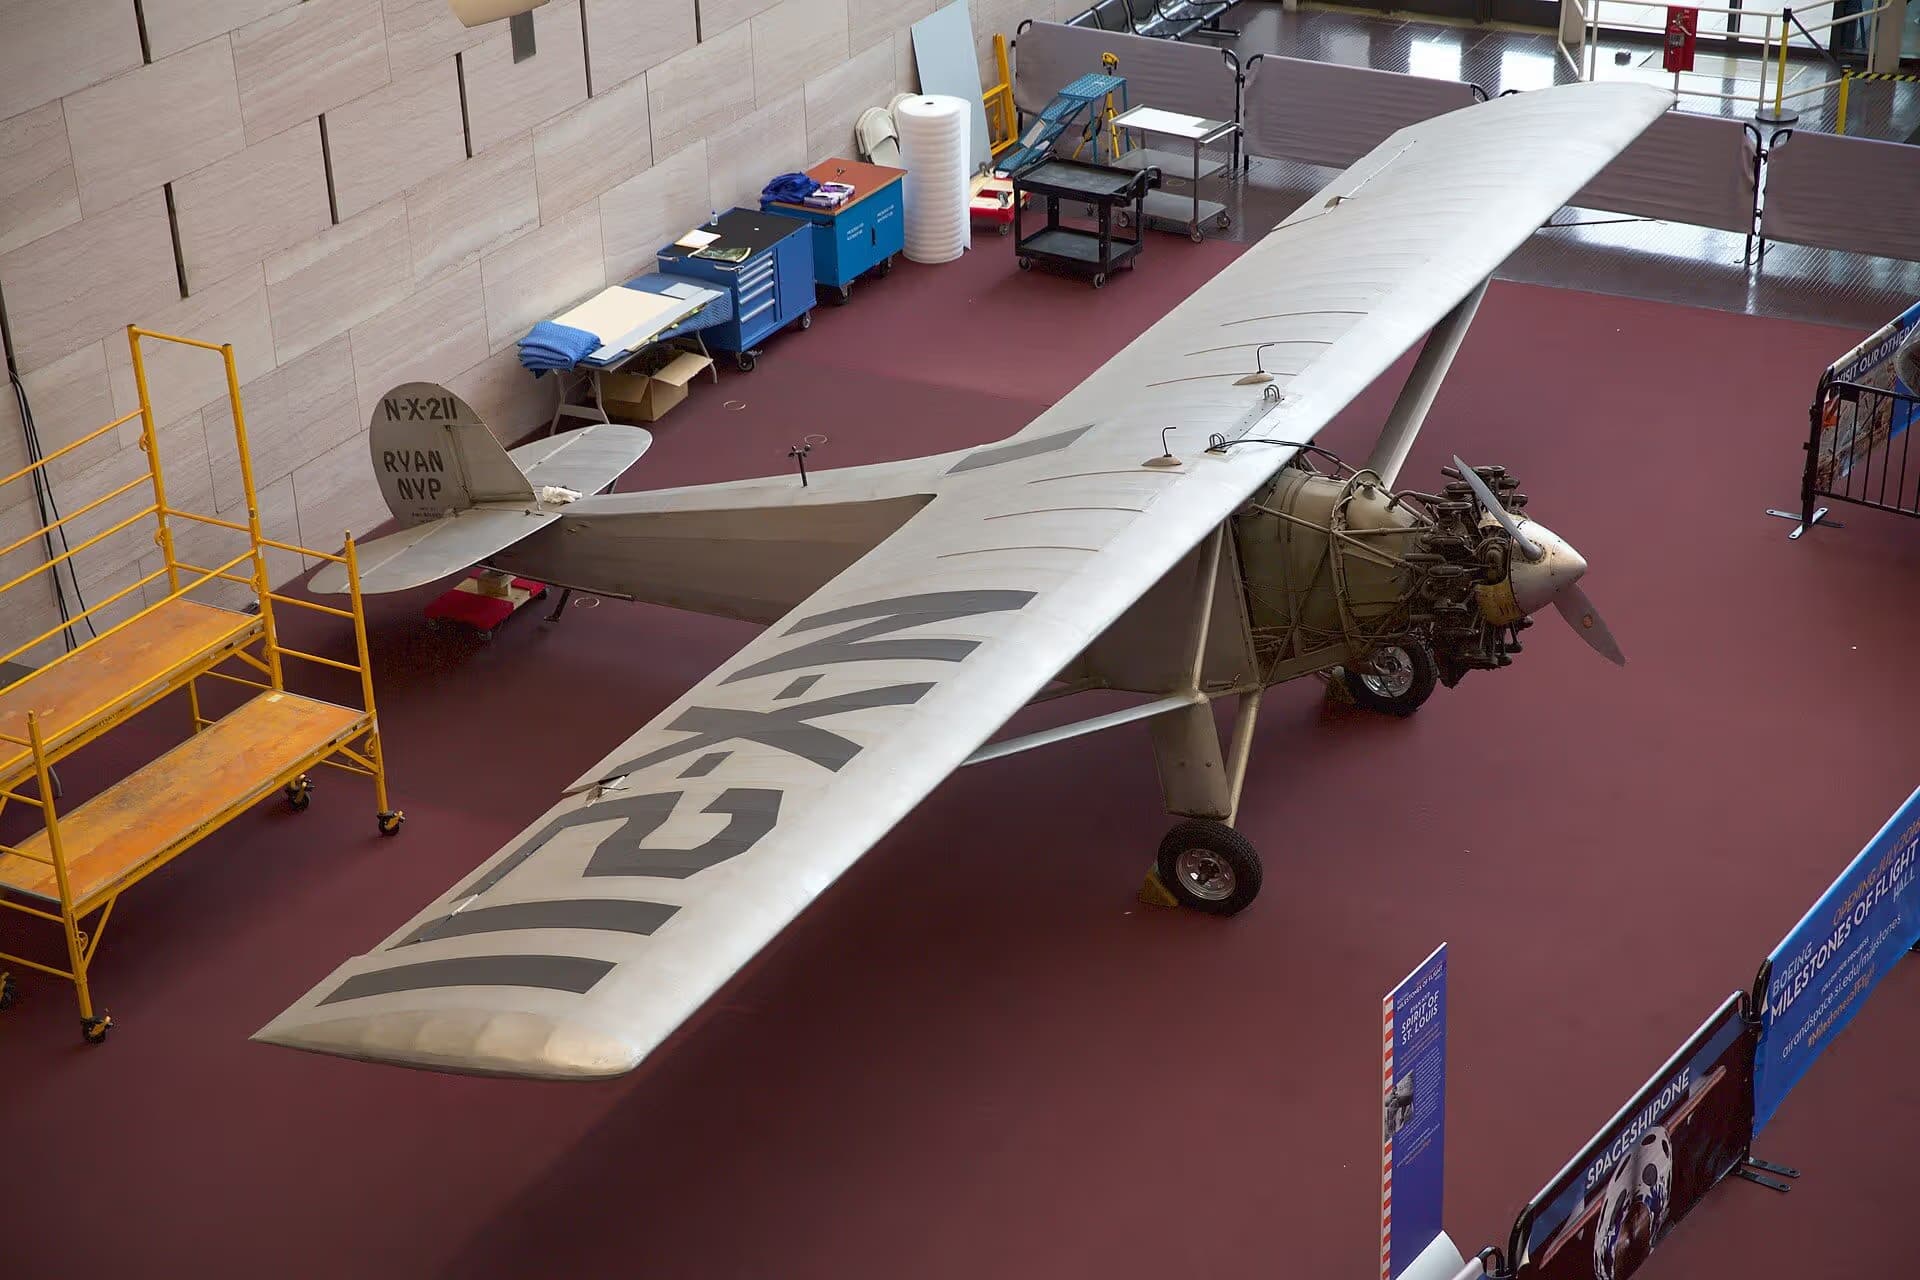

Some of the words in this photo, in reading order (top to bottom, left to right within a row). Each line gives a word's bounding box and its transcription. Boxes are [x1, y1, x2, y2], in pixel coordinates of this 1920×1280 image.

[1860, 349, 1879, 372] OUR
[384, 397, 457, 421] N-X-211
[383, 450, 444, 473] RYAN
[397, 477, 441, 500] NYP
[317, 589, 1039, 1007] N-X-211
[1893, 867, 1914, 903] HALL
[1770, 916, 1851, 1025] MILESTONES
[1854, 890, 1873, 925] OF
[1875, 838, 1918, 904] FLIGHT
[1773, 941, 1812, 998] BOEING
[1782, 913, 1901, 1058] airandspace.si.edu/milestones
[1402, 1001, 1427, 1034] SPIRIT
[1428, 989, 1439, 1008] OF
[1402, 1028, 1413, 1046] ST.
[1414, 1003, 1438, 1034] LOUIS
[1586, 1066, 1690, 1190] SPACESHIPONE
